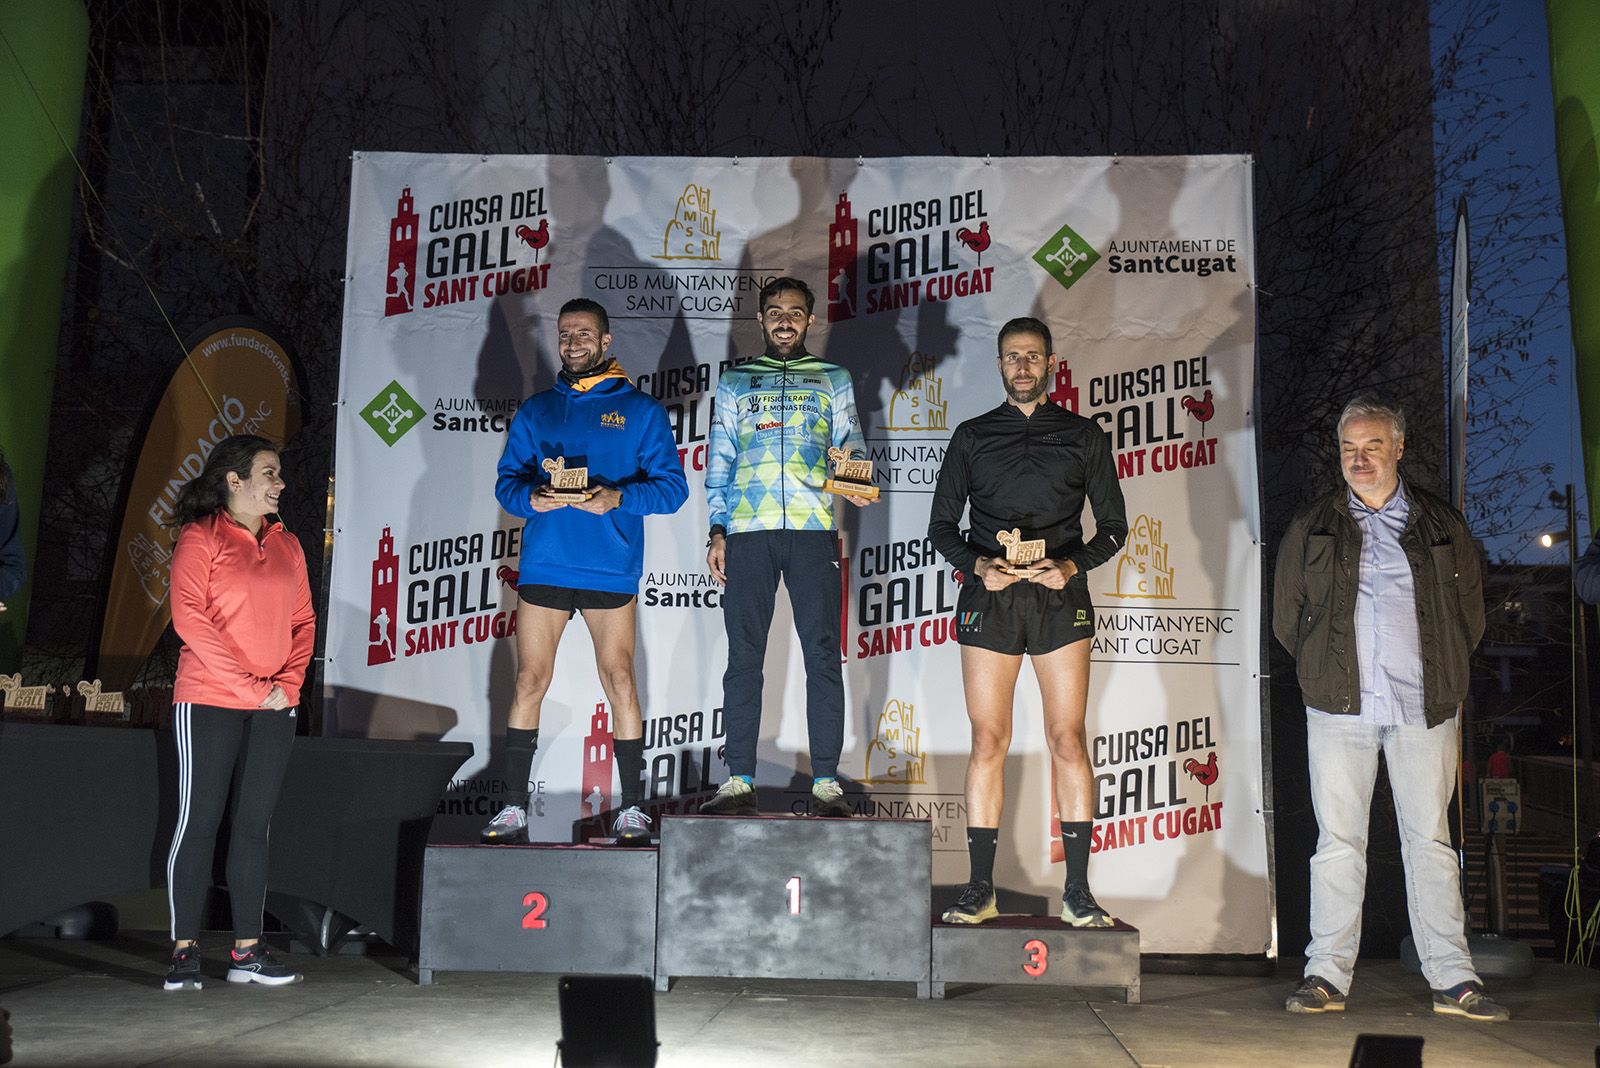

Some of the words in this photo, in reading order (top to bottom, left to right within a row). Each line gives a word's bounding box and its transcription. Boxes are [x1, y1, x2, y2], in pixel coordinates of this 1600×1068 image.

[429, 194, 503, 233] CURSA
[510, 187, 548, 220] DEL
[868, 199, 941, 238] CURSA
[950, 189, 988, 223] DEL
[426, 226, 517, 279] GALL
[867, 230, 959, 285] GALL
[1108, 240, 1212, 253] AJUNTAMENT
[1216, 240, 1236, 252] DE
[1108, 255, 1237, 277] SantCugat
[423, 275, 479, 309] SANT
[482, 263, 551, 298] CUGAT
[594, 274, 638, 290] CLUB
[866, 280, 922, 315] SANT
[926, 266, 994, 302] CUGAT
[626, 295, 675, 311] SANT
[680, 296, 743, 312] CUGAT
[763, 395, 816, 403] FISIOTERAPIA
[1089, 364, 1165, 408] CURSA
[1173, 356, 1212, 390] DEL
[844, 469, 870, 481] GALL
[1151, 438, 1218, 473] CUGAT
[409, 533, 484, 575] CURSA
[491, 527, 524, 560] DE
[860, 536, 936, 578] CURSA
[406, 567, 497, 625] GALL
[646, 572, 719, 587] AJUNTAM
[859, 569, 954, 627] GALL
[404, 620, 459, 657] SANT
[463, 610, 517, 645] CUGA
[857, 623, 915, 659] SANT
[1097, 614, 1233, 635] MUNTANYENC
[1090, 637, 1129, 654] ANT
[1135, 638, 1201, 655] CUGAT
[642, 711, 704, 750] URSA
[1093, 725, 1168, 768] CURSA
[1176, 717, 1216, 753] DEL
[1094, 761, 1187, 820] GALL
[1091, 815, 1147, 853] SANT
[1153, 802, 1223, 841] CUGAT
[521, 892, 548, 929] 2
[786, 876, 801, 915] 1
[1023, 939, 1049, 977] 3
